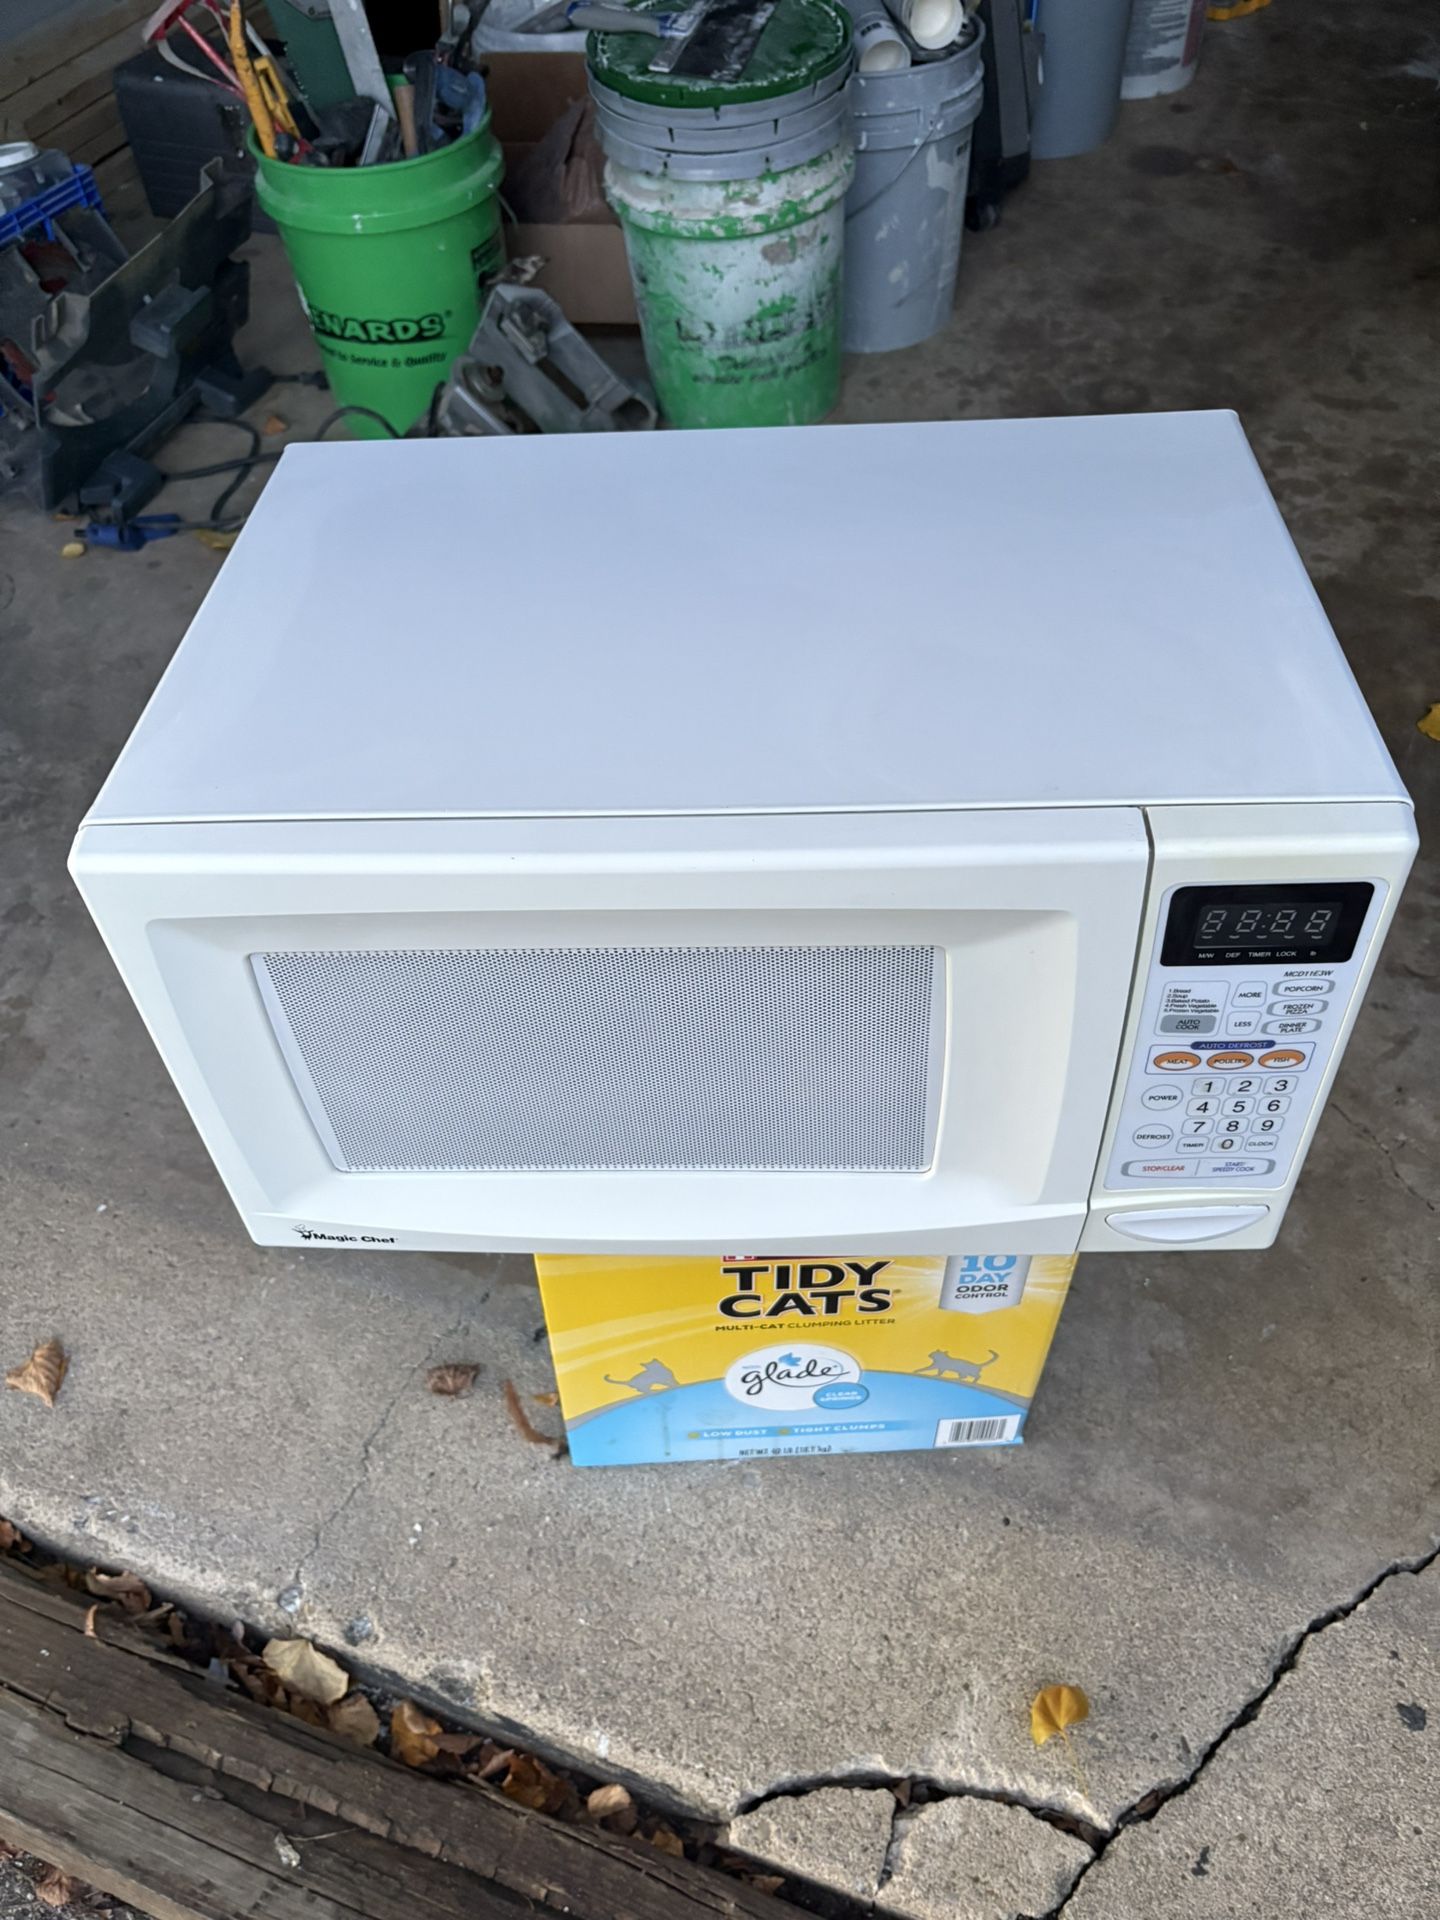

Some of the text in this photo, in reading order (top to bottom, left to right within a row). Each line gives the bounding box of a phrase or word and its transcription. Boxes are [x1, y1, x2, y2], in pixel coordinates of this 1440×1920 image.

[351, 355, 388, 368] Service
[404, 352, 448, 368] Quality
[1205, 1081, 1213, 1092] 1
[1237, 1080, 1252, 1092] 2
[1273, 1079, 1289, 1091] 3
[1196, 1101, 1209, 1113] 4
[1232, 1101, 1246, 1113] 5
[1267, 1100, 1281, 1112] 6
[1193, 1121, 1206, 1133] 7
[1226, 1120, 1240, 1132] 8
[1261, 1119, 1274, 1131] 9
[1220, 1138, 1234, 1150] 0
[313, 1233, 396, 1243] Magic Chef
[960, 1255, 1017, 1272] 10
[722, 1260, 893, 1291] TIDY
[959, 1272, 1013, 1284] DAY
[956, 1284, 1009, 1293] ODOR
[718, 1288, 893, 1318] CATS
[715, 1318, 896, 1332] MULTI-CAT CLUMPING LITTER
[741, 1358, 851, 1396] glade
[703, 1423, 886, 1438] LOW DUST TIGHT CLUMPS
